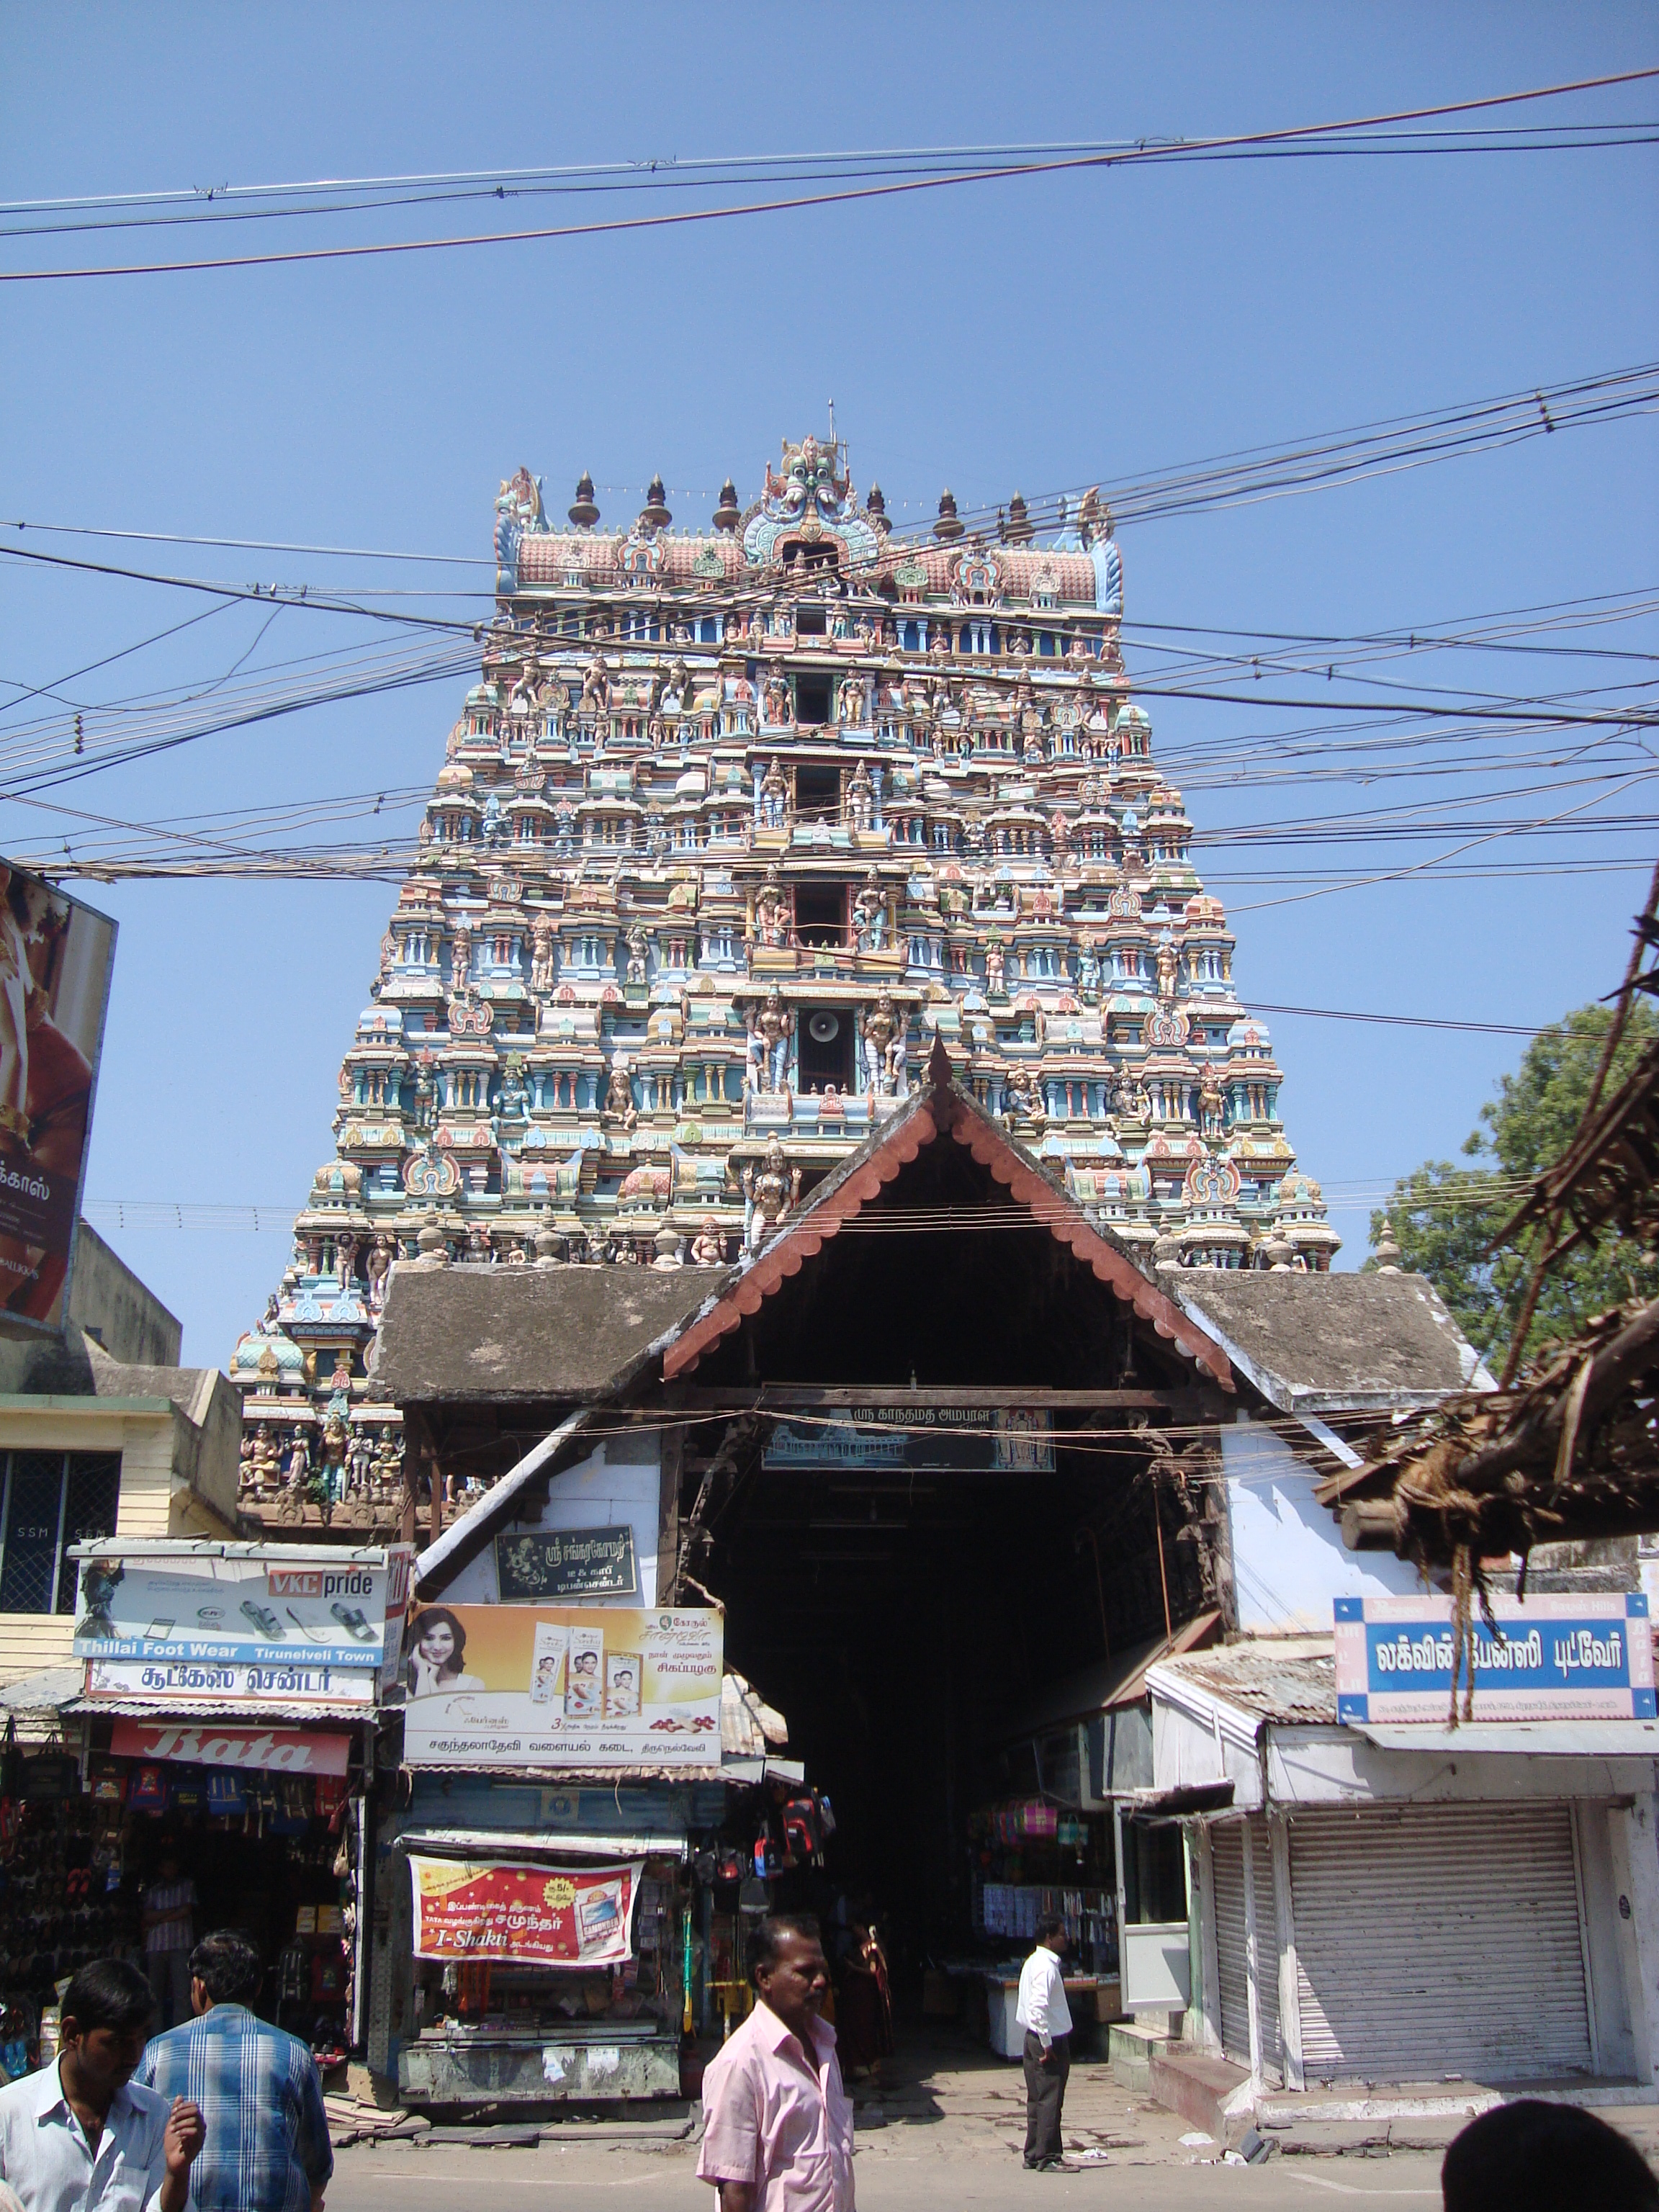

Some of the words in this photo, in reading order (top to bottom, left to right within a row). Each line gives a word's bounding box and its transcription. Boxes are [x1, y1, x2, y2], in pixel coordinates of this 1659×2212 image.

[18, 1527, 48, 1538] SSM
[577, 1568, 587, 1577] &
[271, 1573, 318, 1594] VKC
[324, 1570, 373, 1599] pride
[79, 1640, 137, 1654] Thillai
[143, 1642, 188, 1655] Foot
[189, 1643, 238, 1657] Wear
[254, 1647, 332, 1660] Tirunelveli
[338, 1650, 375, 1662] Town
[1554, 1629, 1622, 1679] புட்வேர்
[657, 1661, 717, 1676] சிகப்பழகு
[247, 1666, 331, 1691] சென்டர்
[144, 1729, 314, 1771] Bata
[429, 1737, 521, 1754] சகுந்தலாதேவி
[529, 1740, 590, 1753] வளையல்
[641, 1743, 706, 1755] திருநெல்வேலி
[425, 1915, 443, 1924] TATA
[495, 1912, 563, 1932] சமுந்தர்
[435, 1928, 509, 1948] I-Shakti
